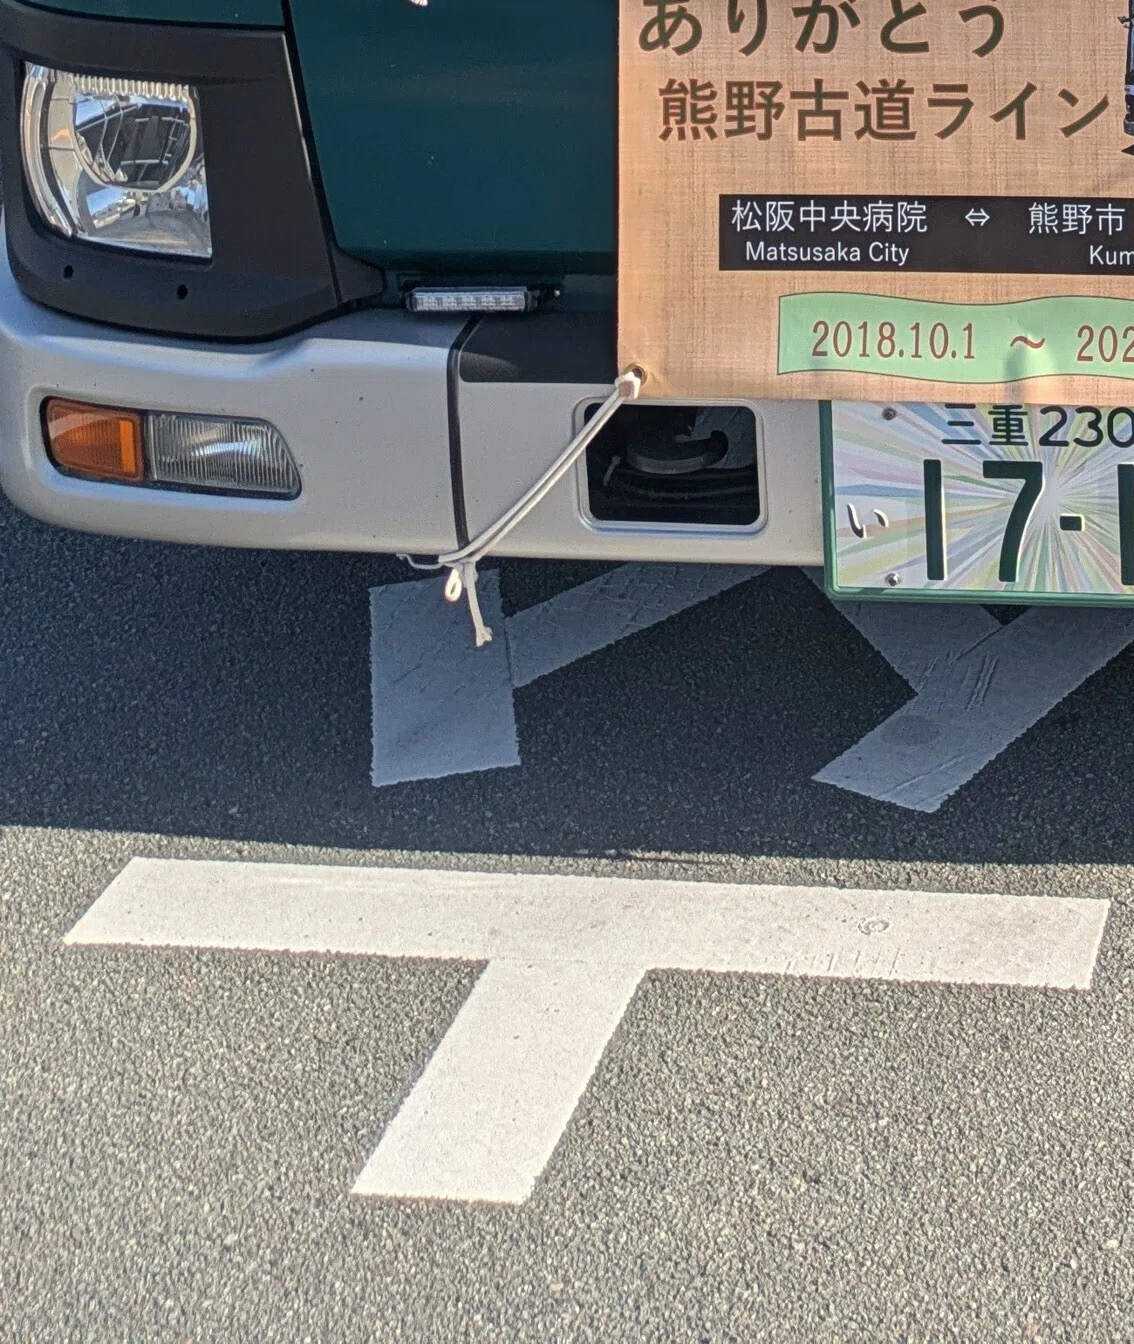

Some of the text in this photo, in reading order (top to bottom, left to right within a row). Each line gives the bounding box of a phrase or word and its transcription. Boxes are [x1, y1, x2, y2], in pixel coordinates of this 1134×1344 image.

[658, 78, 1109, 142] 熊野古道ライン
[732, 199, 928, 232] 松阪中央病院
[745, 241, 909, 266] Matsusaka City
[811, 320, 976, 359] 2018.10.1
[847, 503, 889, 539] い
